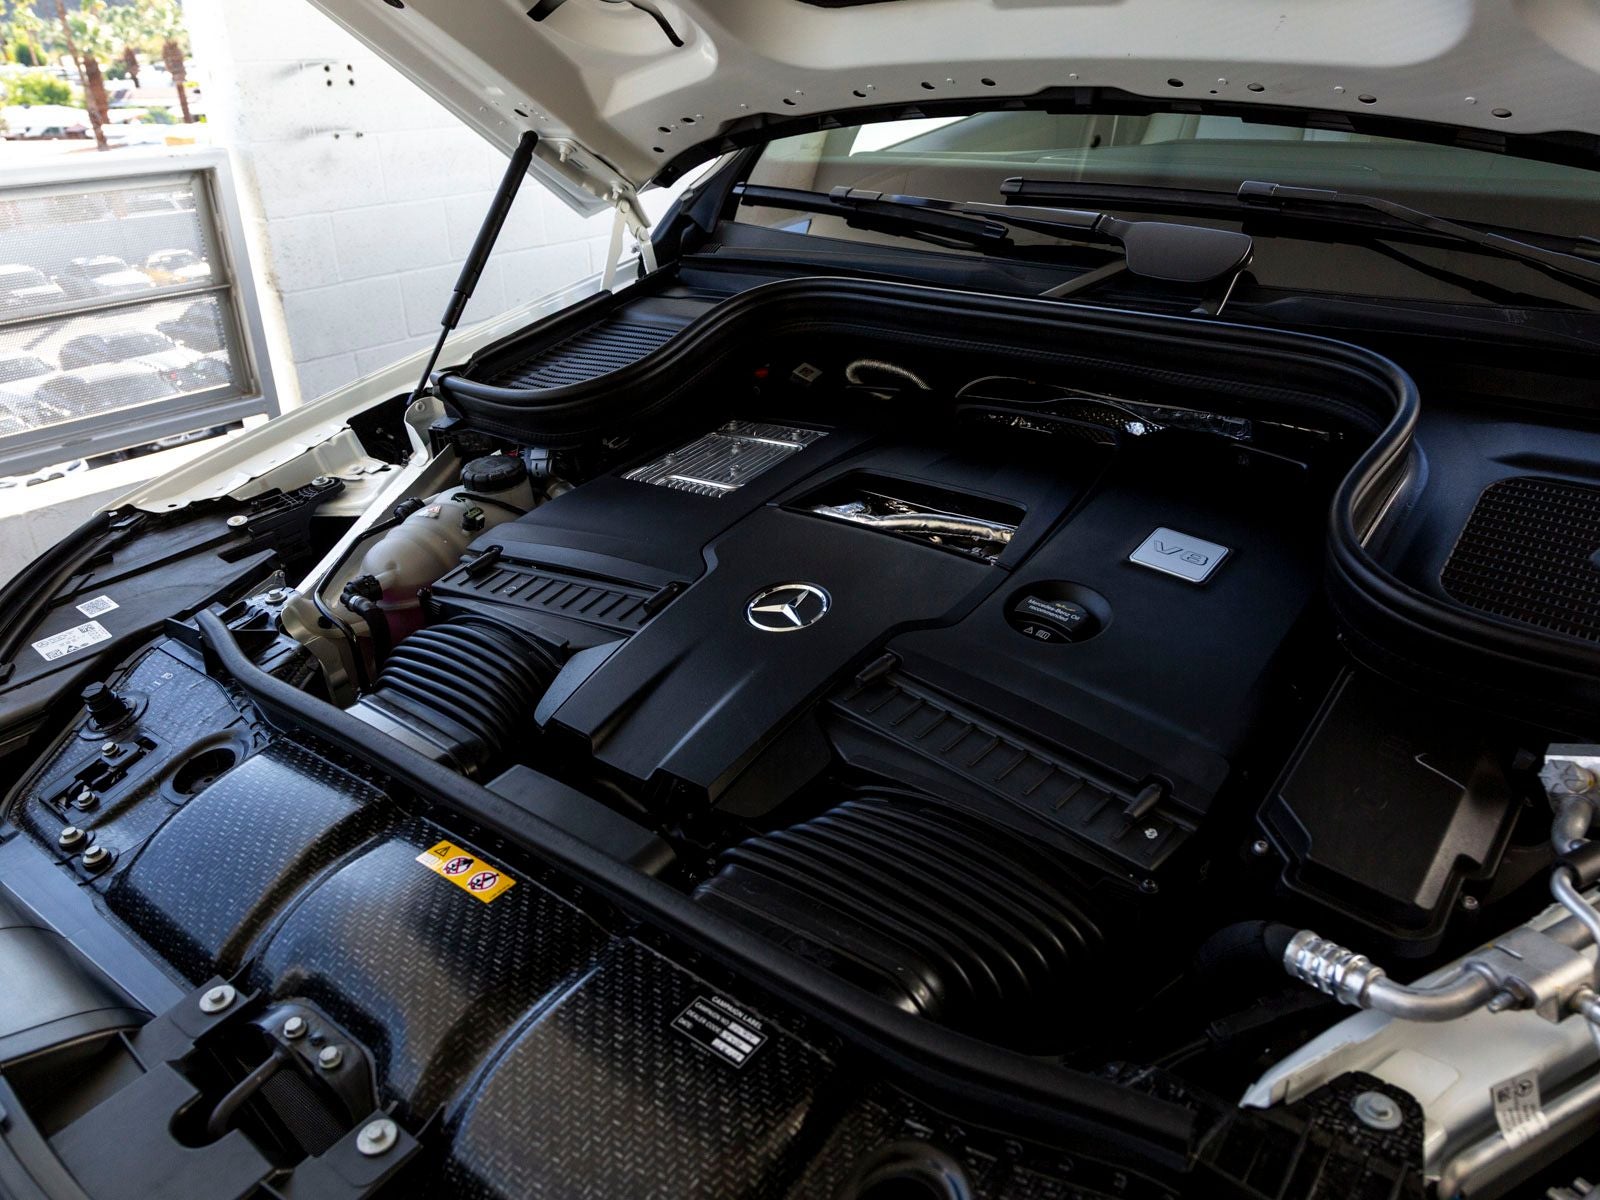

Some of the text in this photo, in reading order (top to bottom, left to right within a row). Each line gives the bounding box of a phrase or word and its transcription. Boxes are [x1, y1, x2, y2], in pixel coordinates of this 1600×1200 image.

[1154, 539, 1209, 566] V8
[685, 1009, 707, 1024] DEALER
[694, 1001, 721, 1020] CAMPAIGN
[711, 995, 762, 1030] CAMPAIGN LABEL
